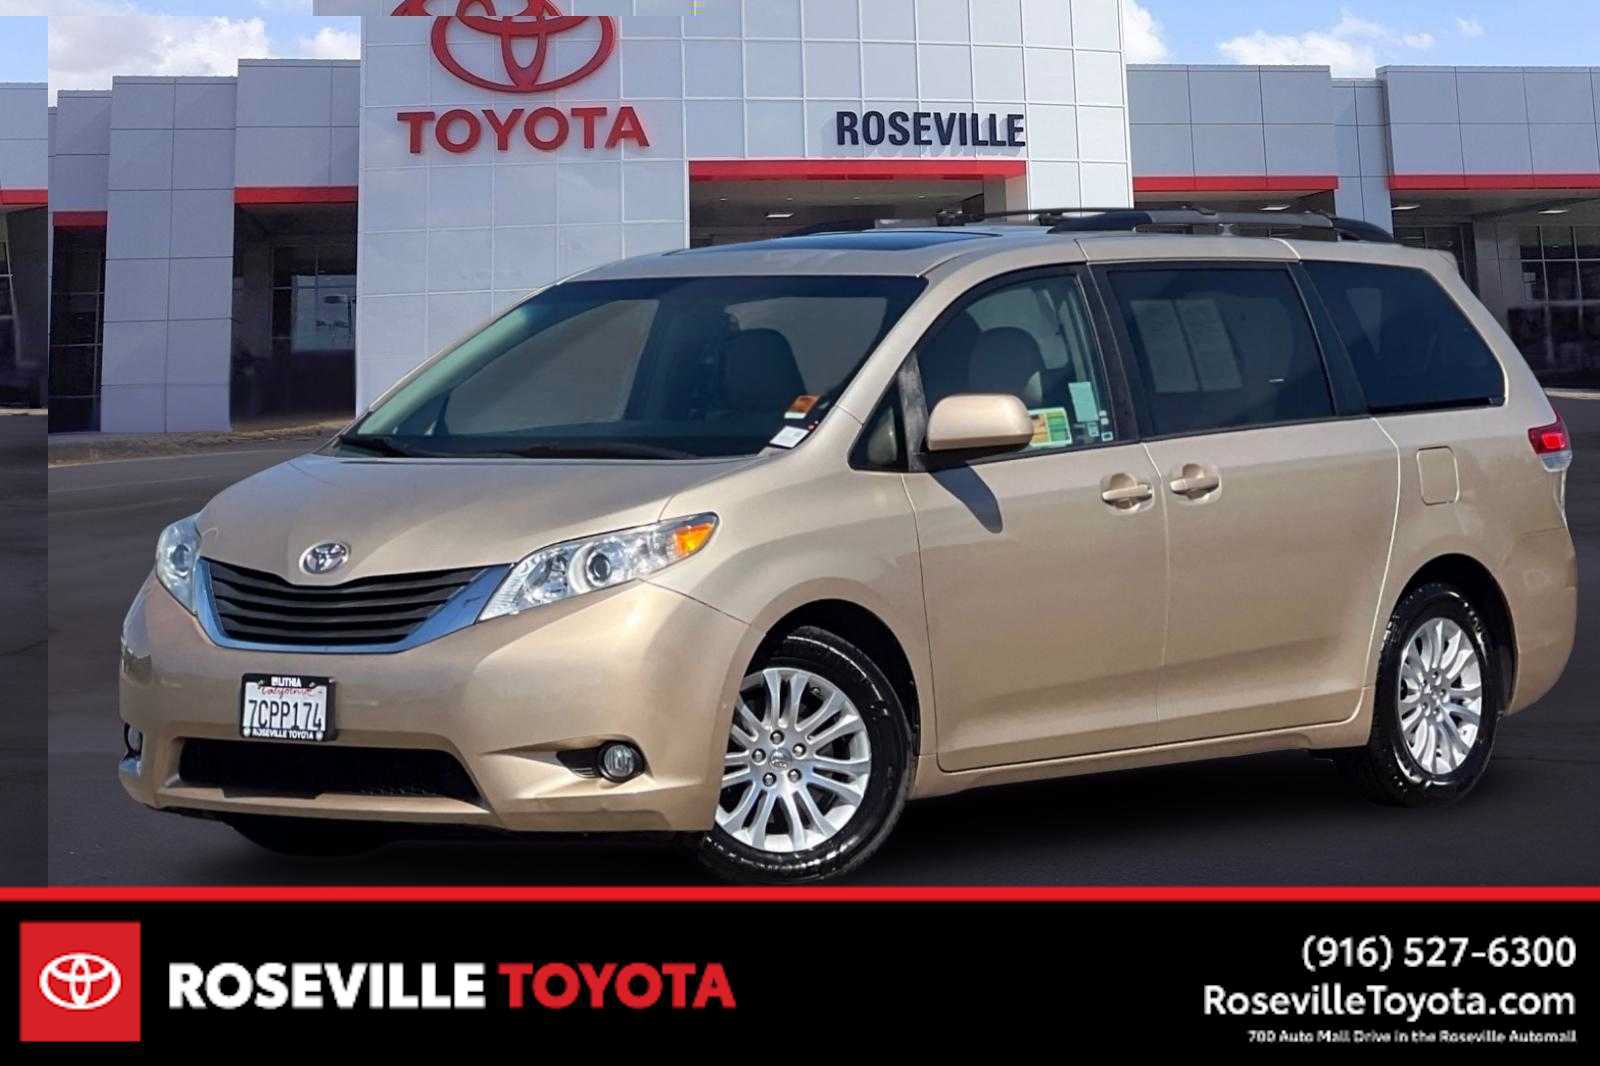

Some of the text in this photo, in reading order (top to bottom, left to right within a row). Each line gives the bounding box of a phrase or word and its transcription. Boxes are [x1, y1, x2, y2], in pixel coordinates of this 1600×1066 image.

[397, 106, 650, 154] TOYOTA
[836, 111, 1026, 147] ROSEVILLE
[248, 700, 322, 731] 7CPP174
[289, 730, 314, 739] TOYOTA
